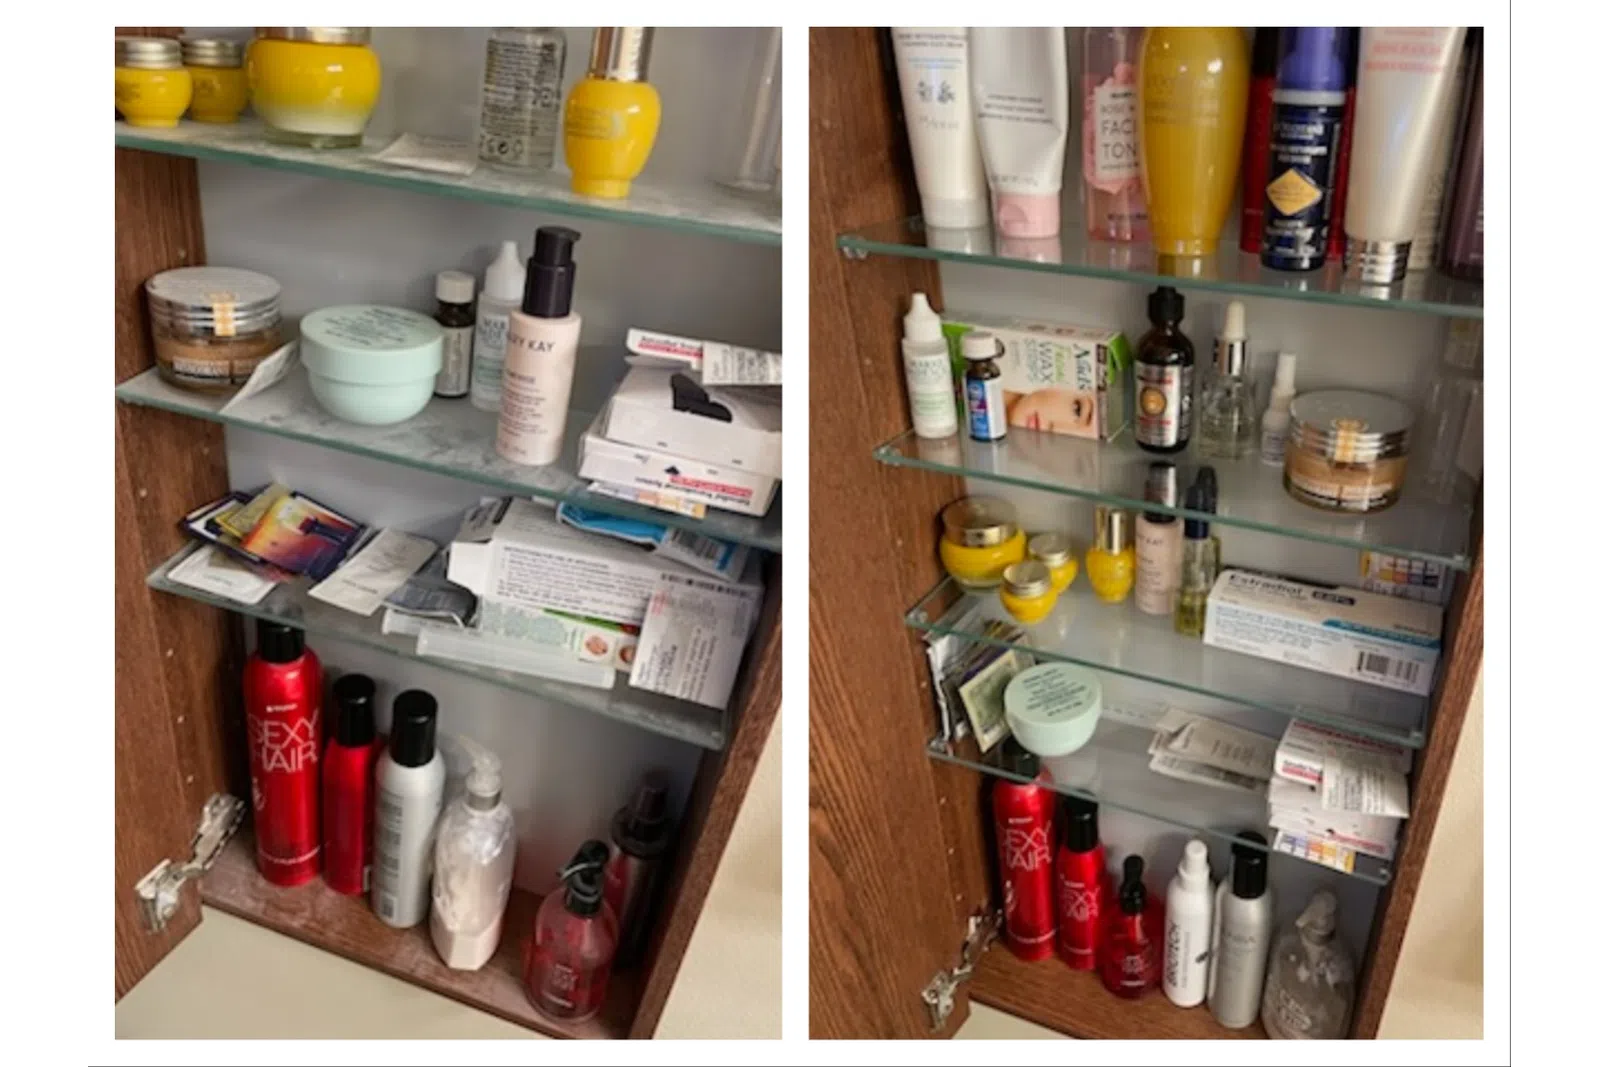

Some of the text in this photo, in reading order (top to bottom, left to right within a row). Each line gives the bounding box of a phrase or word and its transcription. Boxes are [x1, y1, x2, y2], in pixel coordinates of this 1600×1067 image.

[528, 339, 555, 352] KAY
[1228, 573, 1303, 597] Estradiol
[998, 819, 1052, 851] EXY
